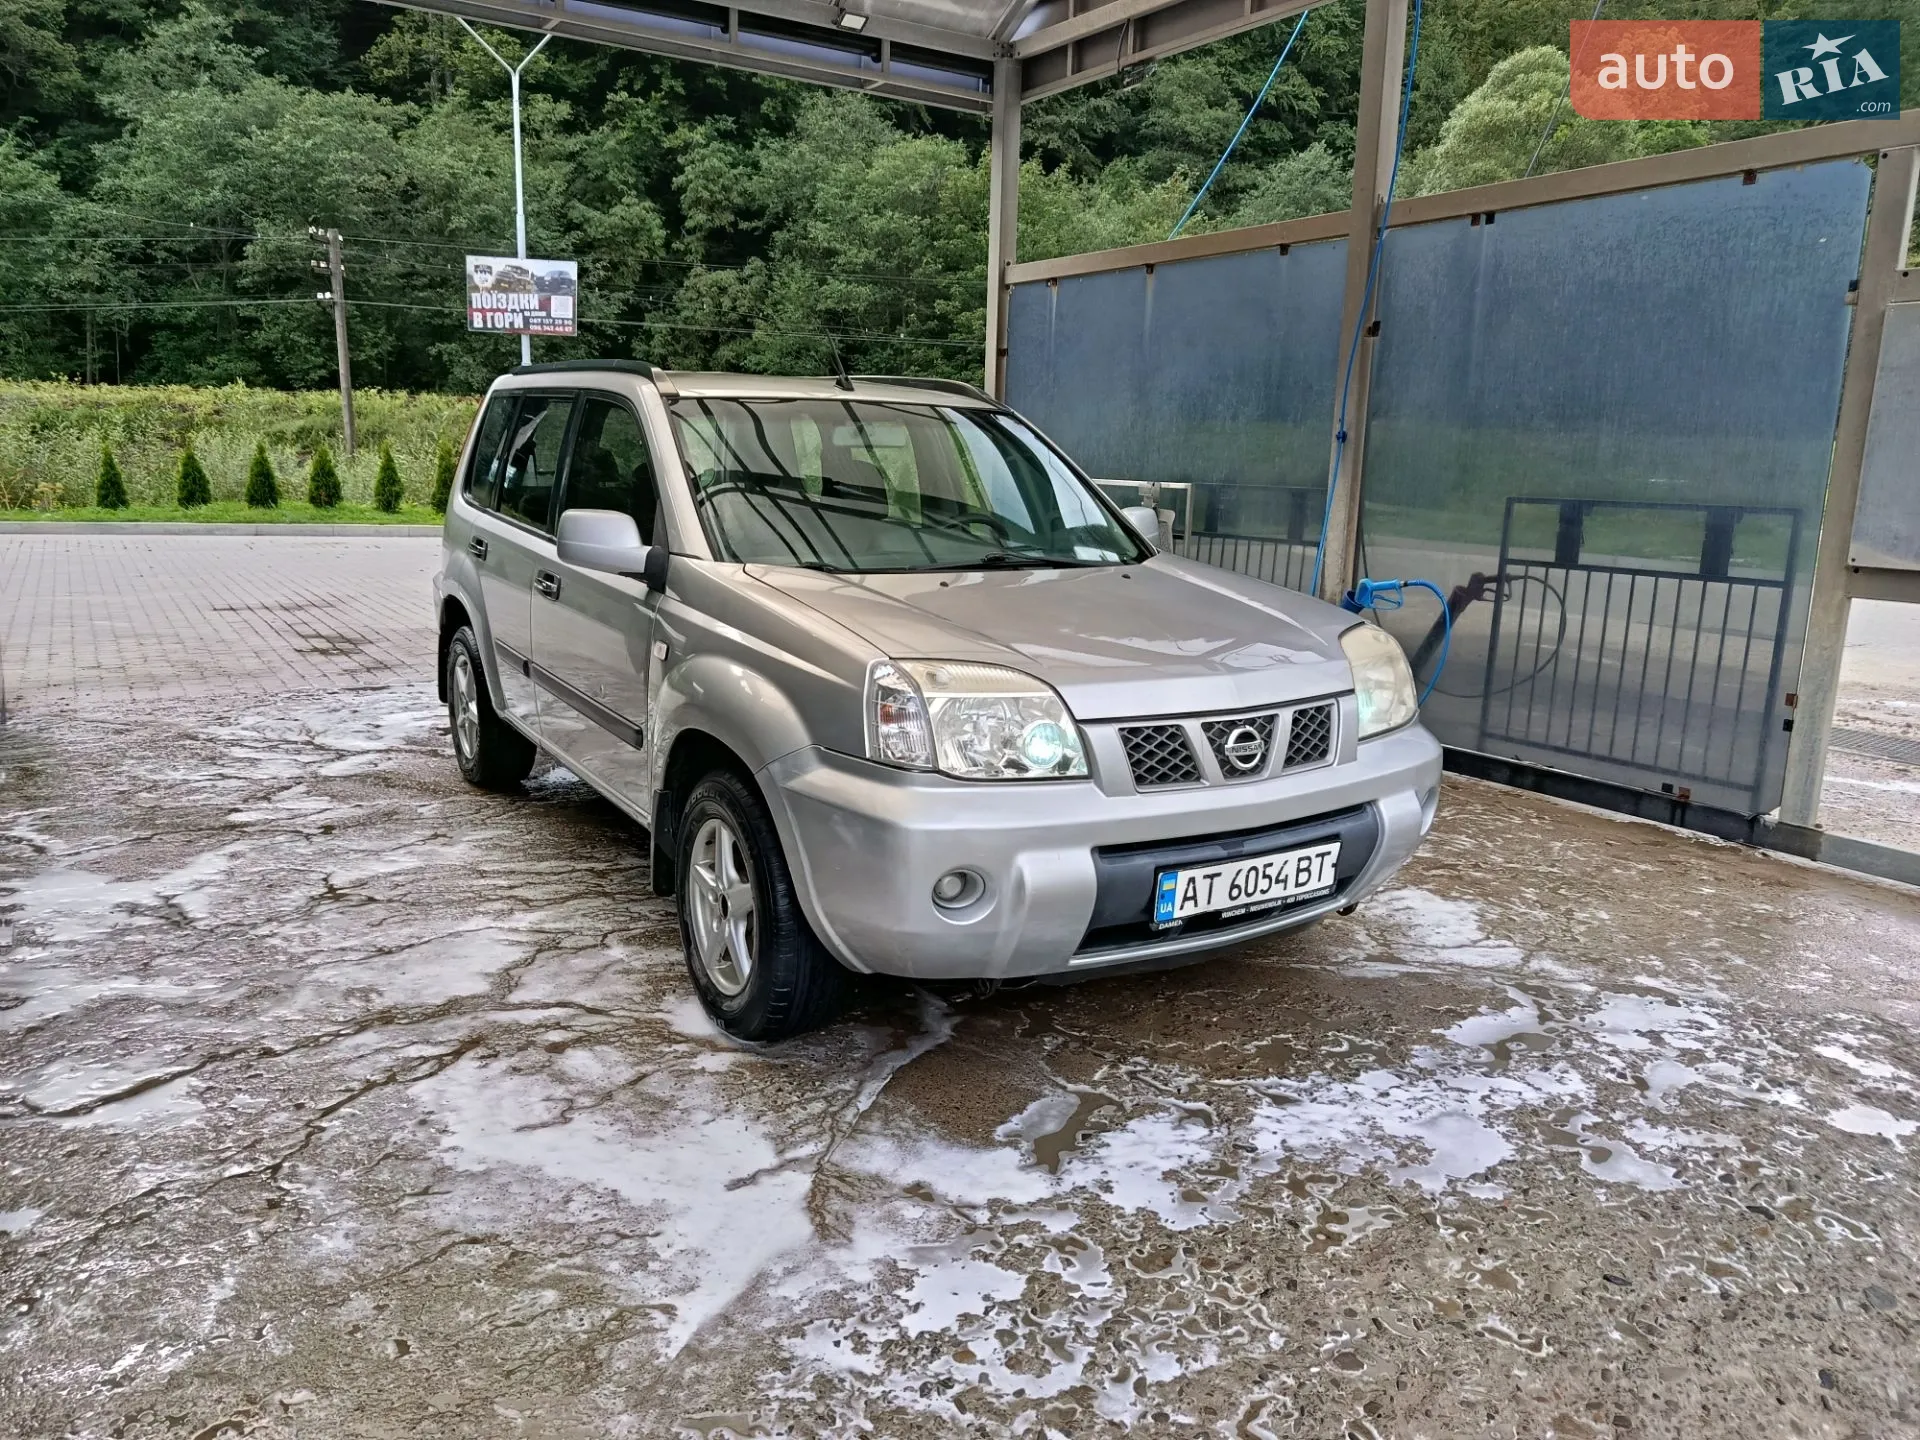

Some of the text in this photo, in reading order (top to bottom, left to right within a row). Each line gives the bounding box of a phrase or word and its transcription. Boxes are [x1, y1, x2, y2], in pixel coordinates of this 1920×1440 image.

[471, 291, 540, 311] ПОЇЗДКИ
[473, 312, 524, 329] В ГОРИ
[1231, 741, 1262, 754] NISSAN
[1179, 851, 1332, 911] AT 6054 BT
[1160, 902, 1173, 914] UA
